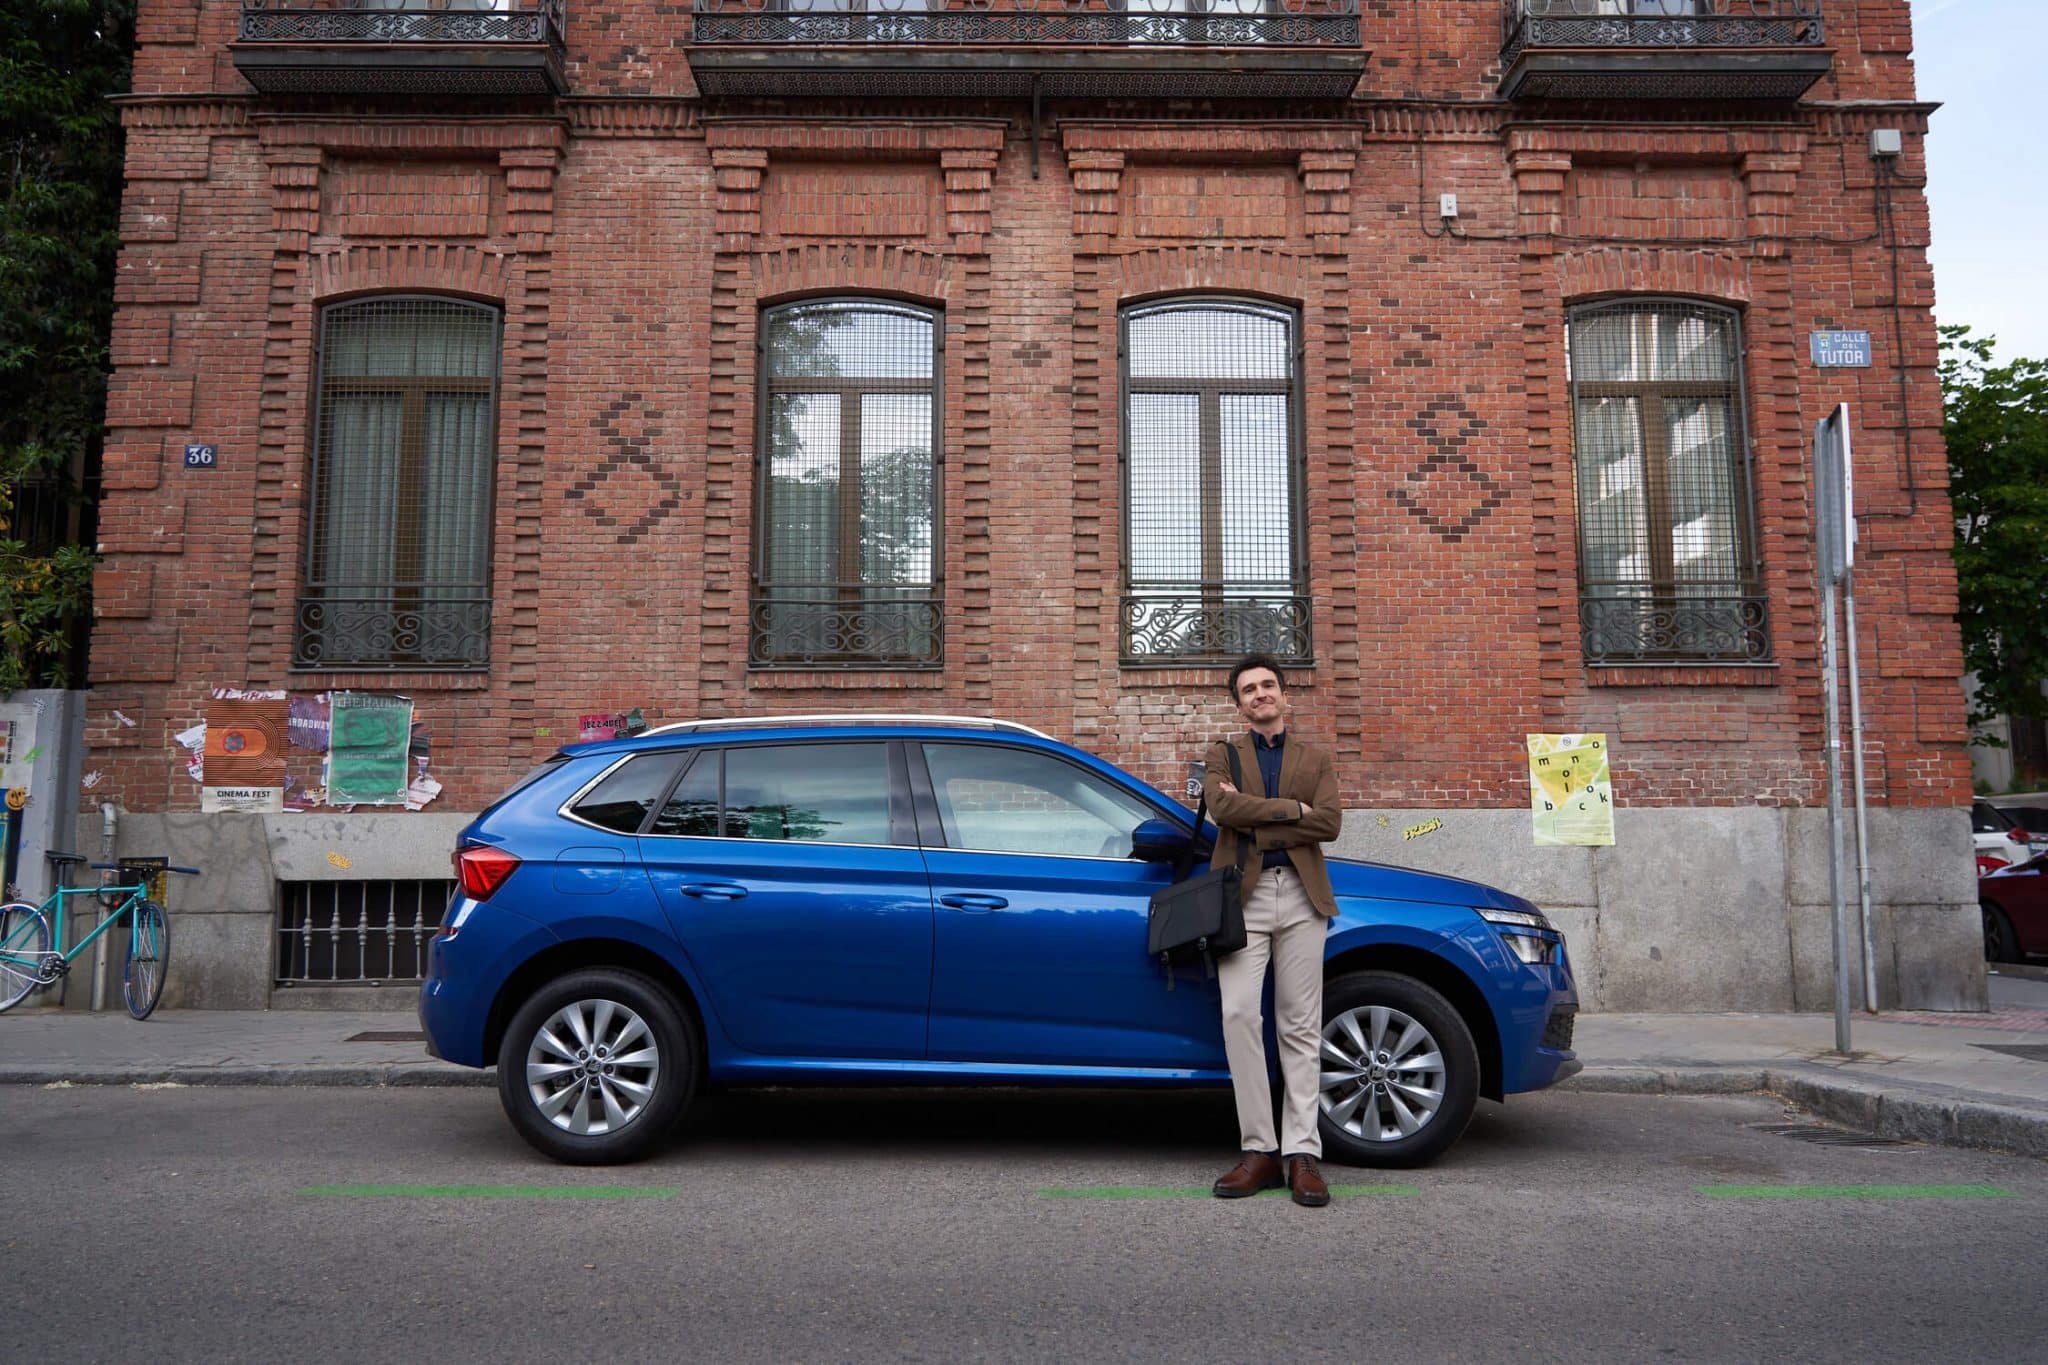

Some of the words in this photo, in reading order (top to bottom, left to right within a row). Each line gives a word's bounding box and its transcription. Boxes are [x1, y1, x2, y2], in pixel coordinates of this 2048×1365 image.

[1834, 333, 1867, 343] CALLE
[1819, 350, 1864, 364] TUTOR
[188, 447, 213, 465] 36
[216, 790, 250, 798] CINEMA
[252, 790, 272, 799] FEST
